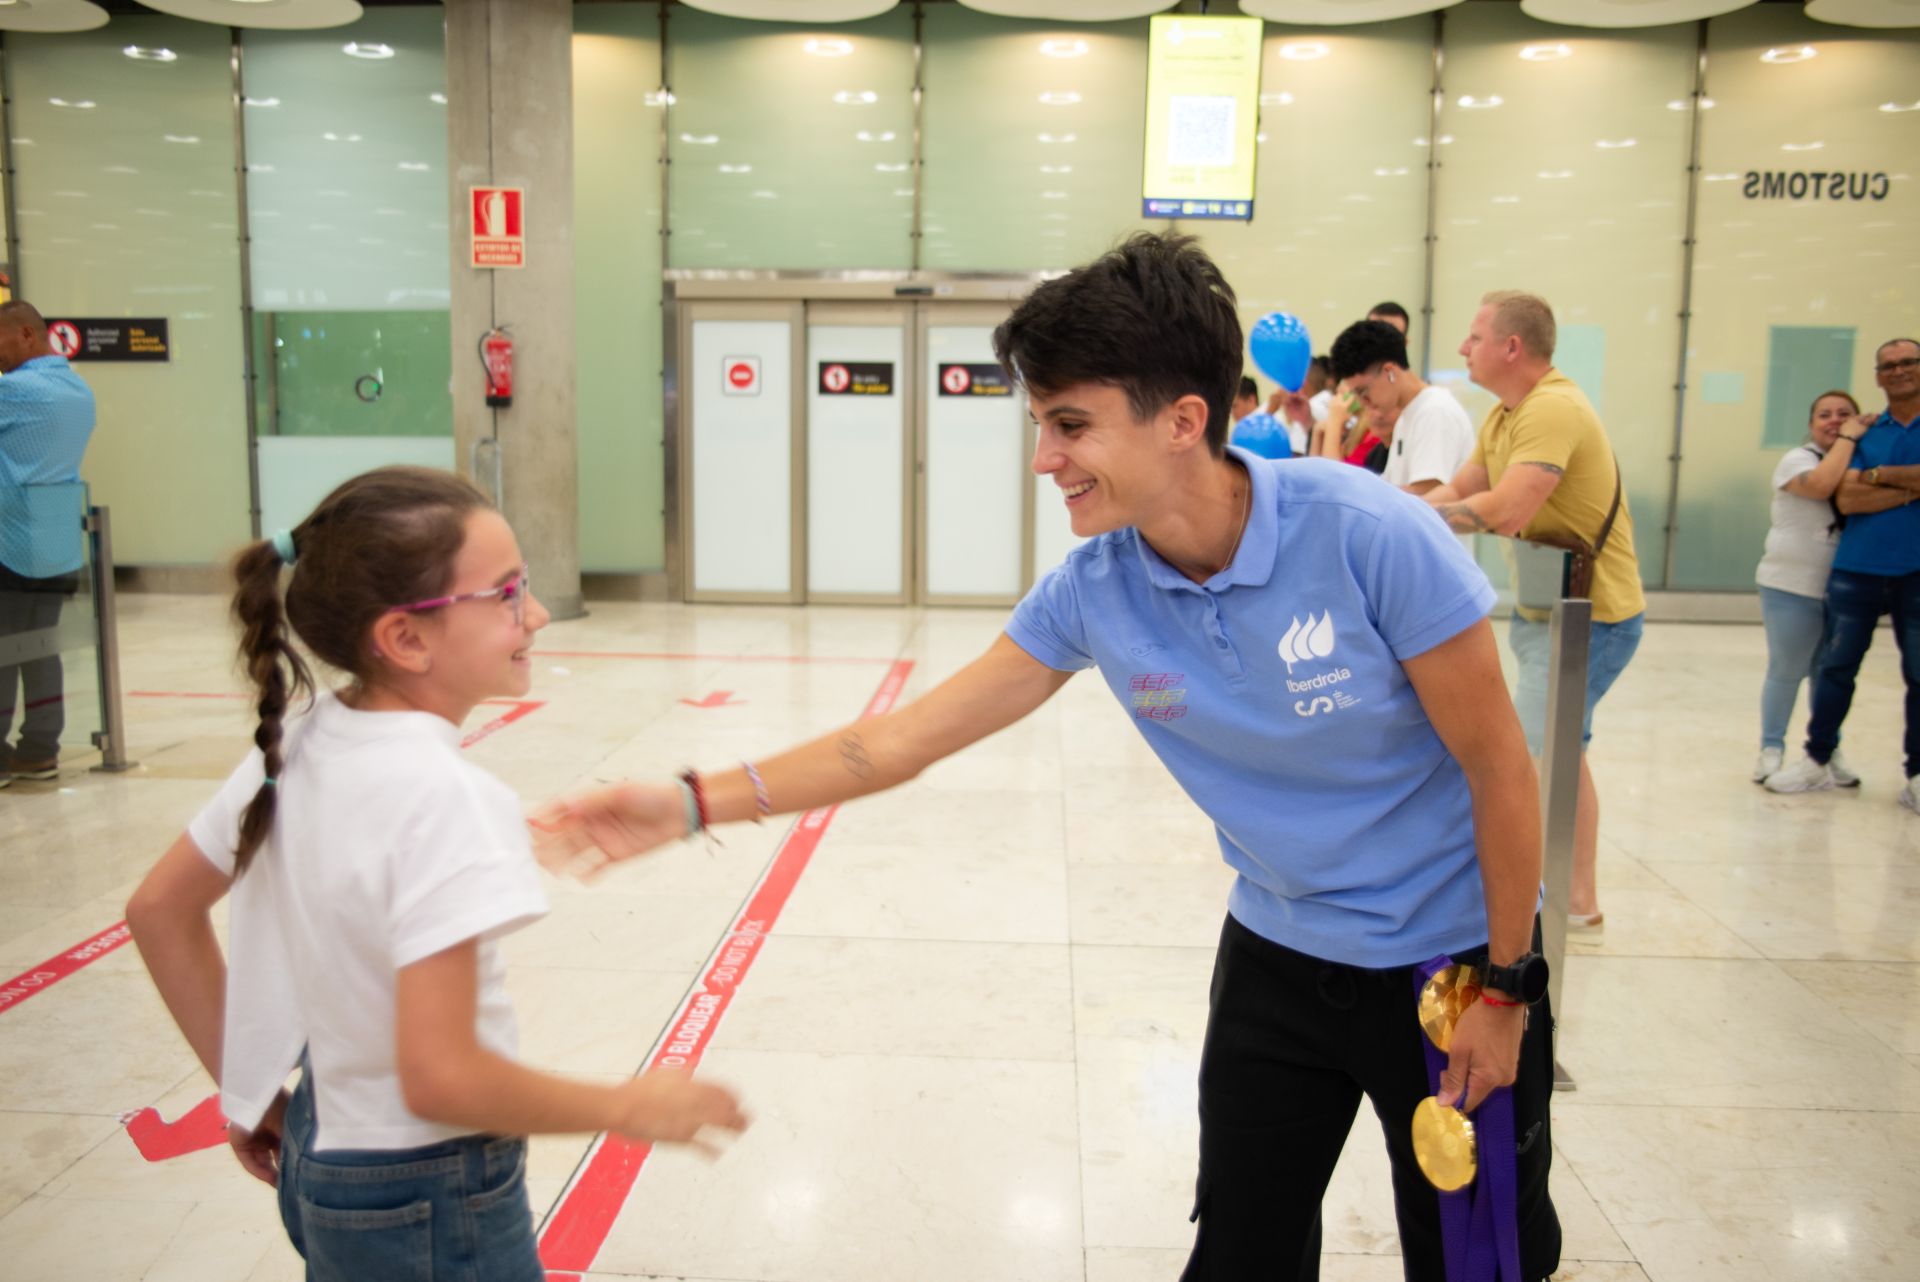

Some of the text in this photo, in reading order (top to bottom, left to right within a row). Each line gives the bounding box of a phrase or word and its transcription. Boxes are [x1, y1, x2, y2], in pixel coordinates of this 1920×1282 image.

[1285, 667, 1352, 694] Iberdrola
[667, 993, 723, 1055] BLOQUEAR
[720, 946, 750, 968] NOT
